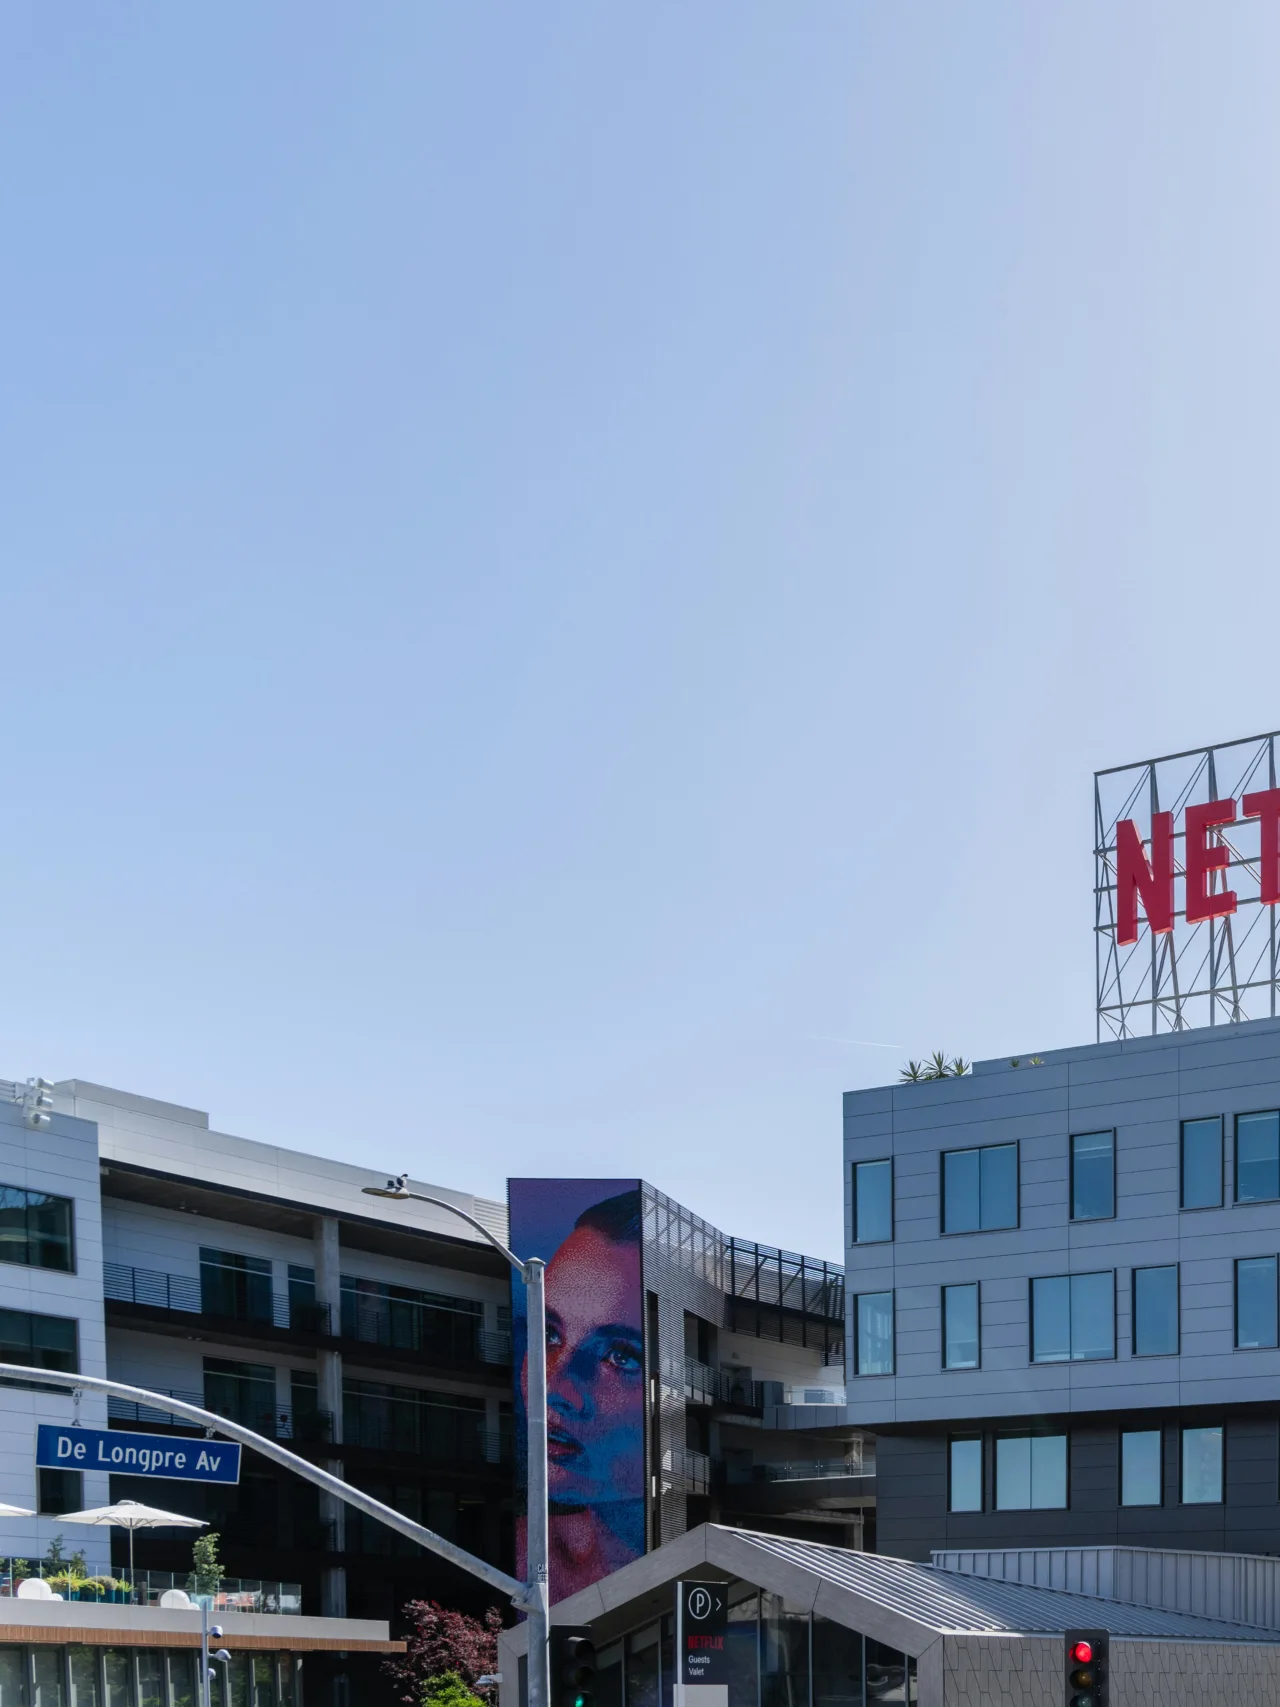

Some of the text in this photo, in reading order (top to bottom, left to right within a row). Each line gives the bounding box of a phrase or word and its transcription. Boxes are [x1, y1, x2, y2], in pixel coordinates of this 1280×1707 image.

[57, 1436, 222, 1472] De Longpre Av
[687, 1635, 724, 1650] NETFLIX
[688, 1655, 711, 1664] Guests
[688, 1667, 705, 1676] Valet
